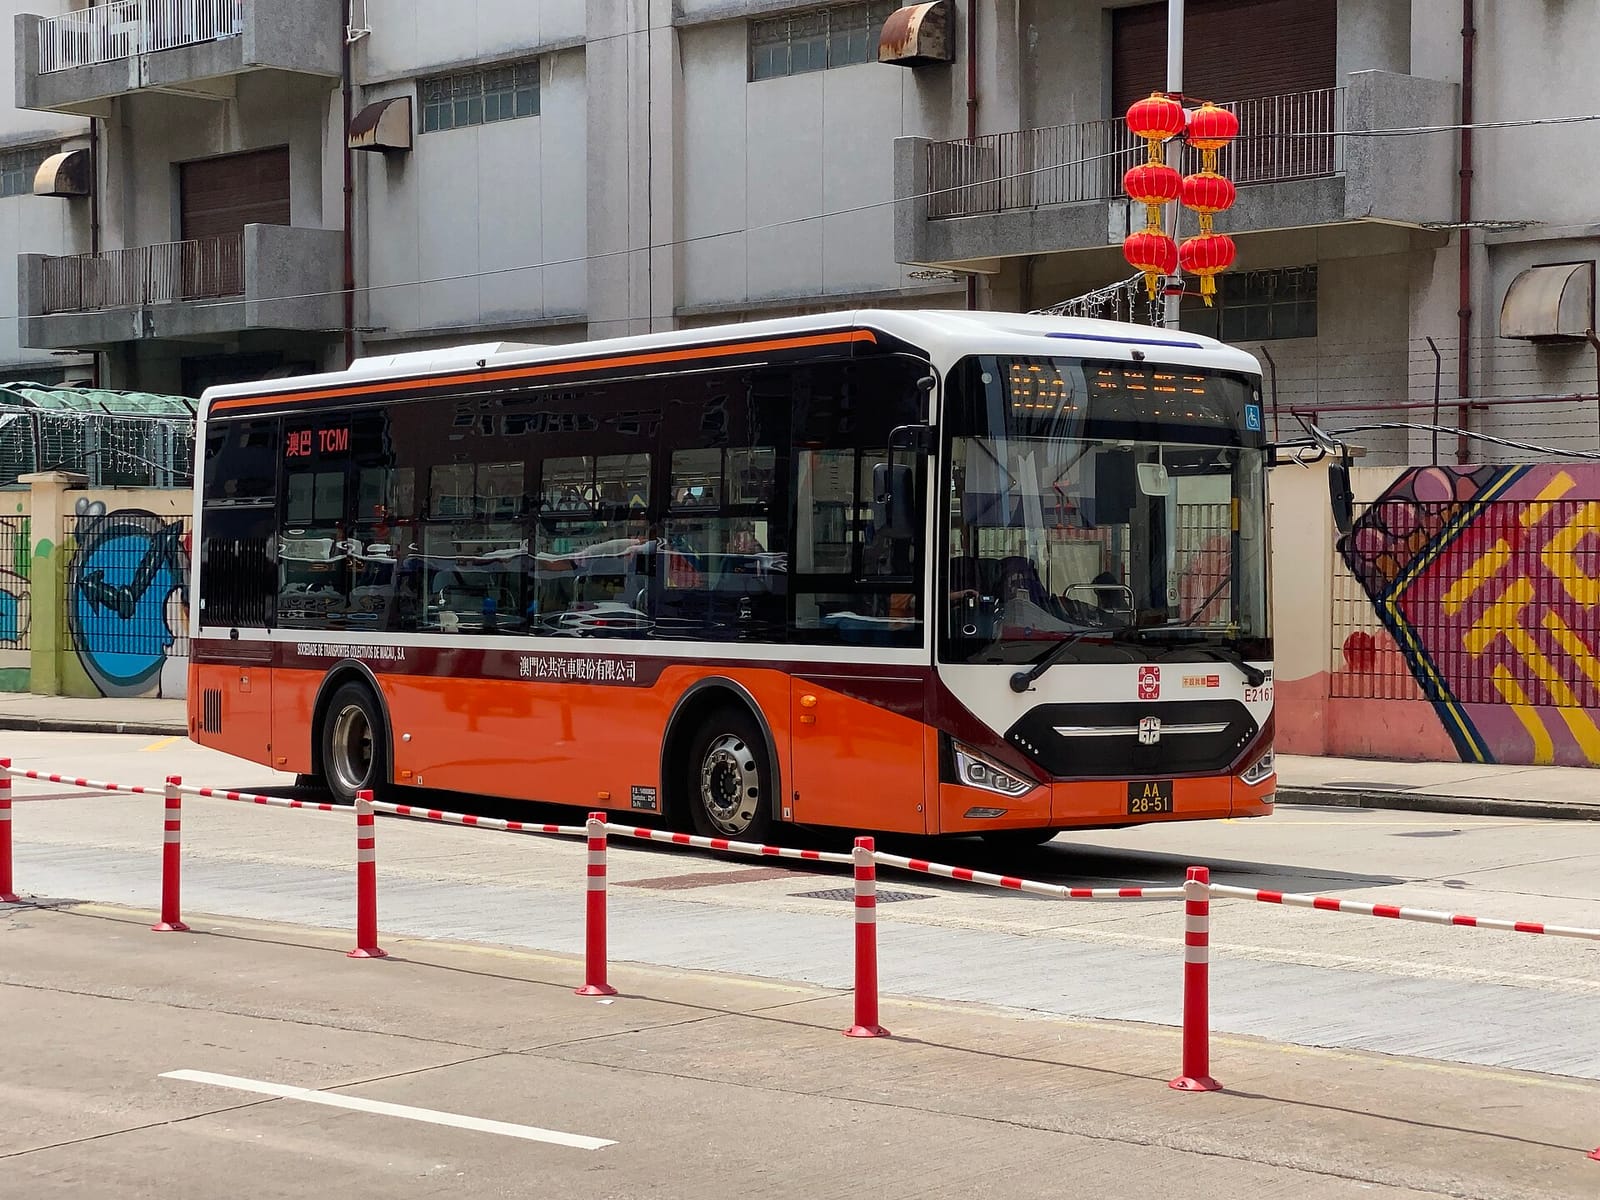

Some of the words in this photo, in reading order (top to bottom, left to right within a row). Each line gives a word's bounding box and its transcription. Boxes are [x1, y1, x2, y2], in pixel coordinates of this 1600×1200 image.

[286, 431, 311, 457] 澳巴
[319, 428, 349, 452] TCM
[318, 643, 323, 656] DE
[374, 646, 380, 659] DE
[520, 656, 636, 682] 澳門公共汽車股份有限公司
[1143, 783, 1159, 797] AA
[1131, 797, 1168, 812] 28-51
